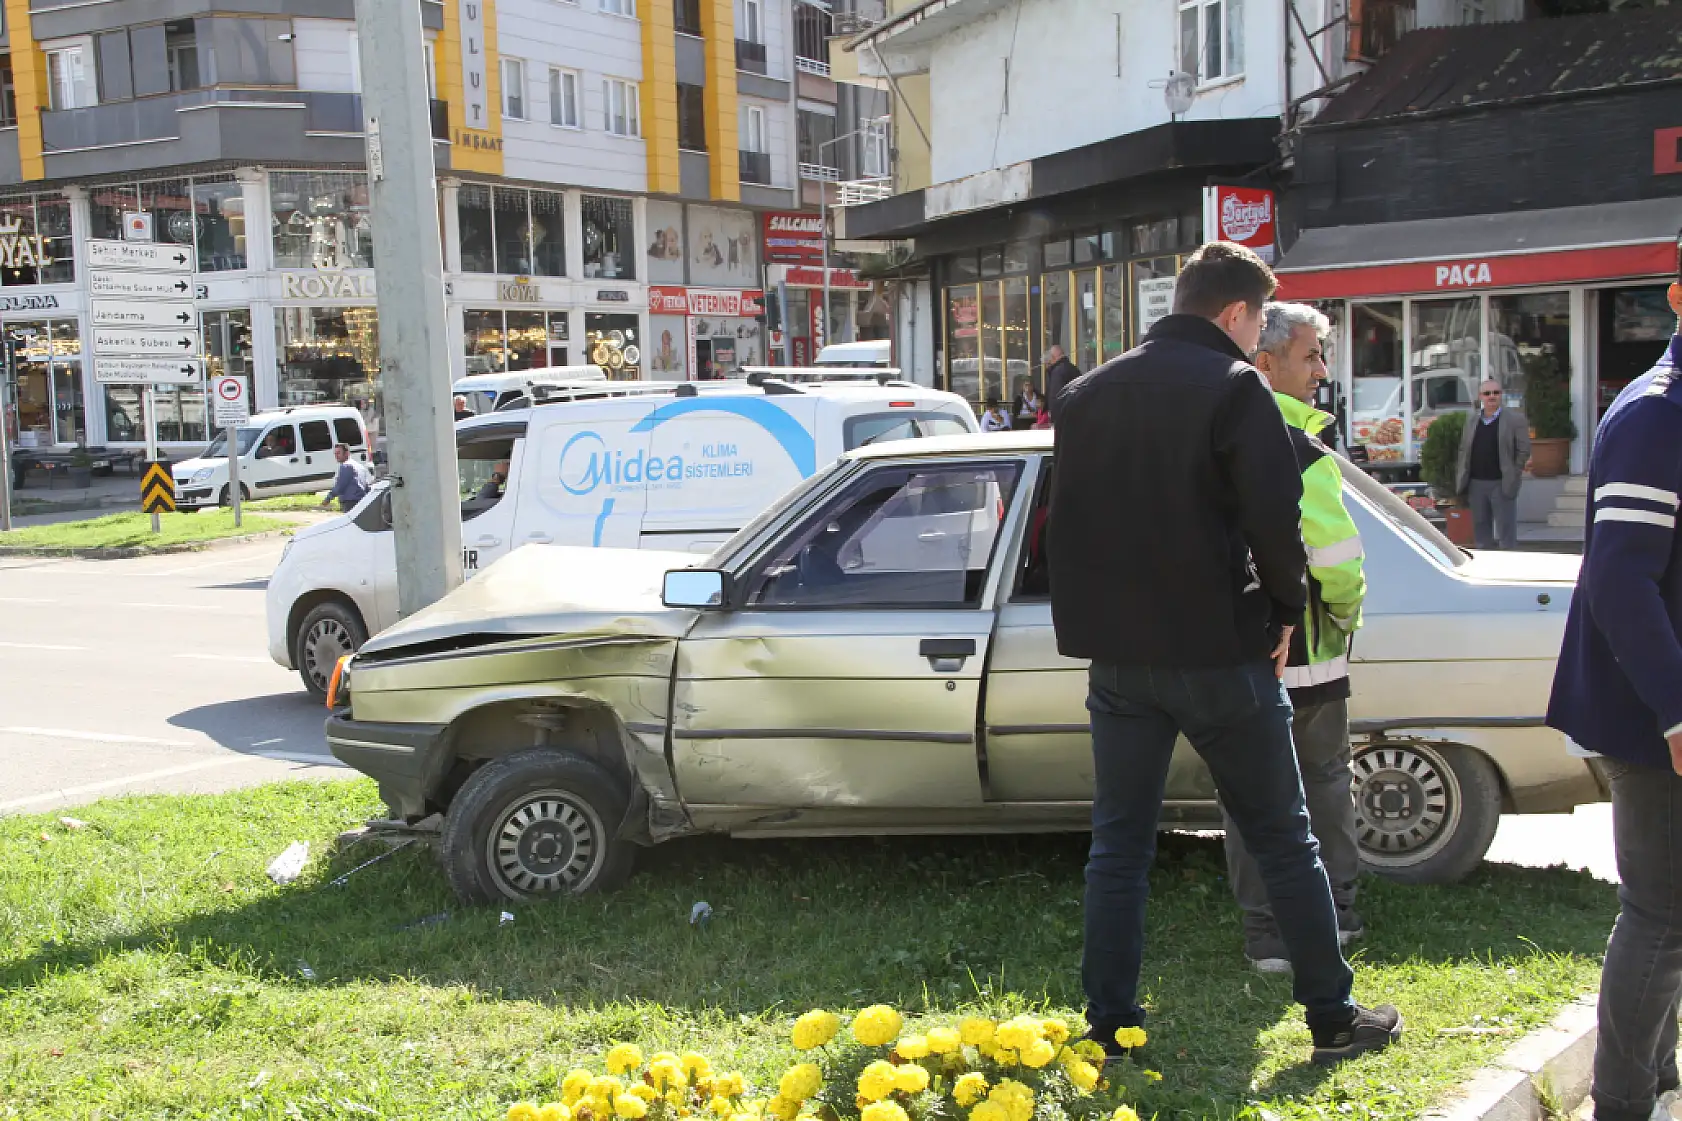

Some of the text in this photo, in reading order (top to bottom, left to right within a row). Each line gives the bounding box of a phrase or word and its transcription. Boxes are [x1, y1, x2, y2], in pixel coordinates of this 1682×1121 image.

[0, 232, 53, 268] YAL
[1436, 262, 1492, 286] PAÇA
[282, 272, 377, 299] ROYAL
[502, 283, 543, 301] ROYAL
[96, 310, 145, 321] Jandarma
[702, 440, 738, 458] KLİMA
[559, 431, 684, 496] Midea
[685, 459, 753, 478] SİSTEMLERİ
